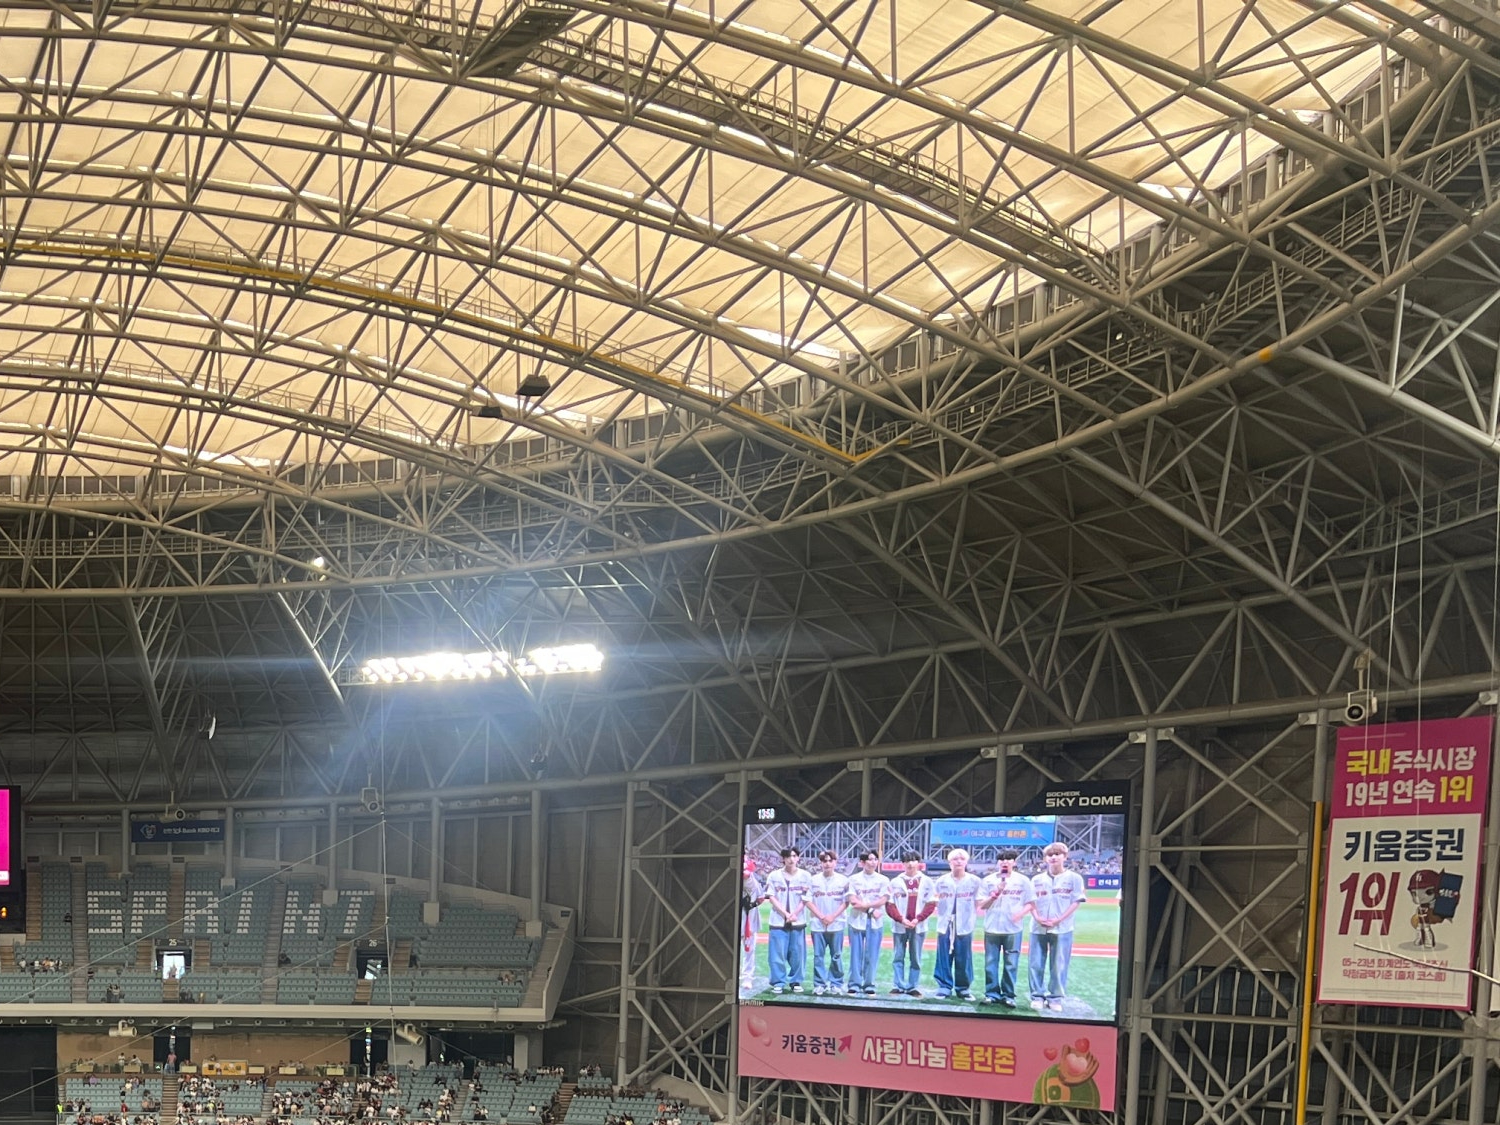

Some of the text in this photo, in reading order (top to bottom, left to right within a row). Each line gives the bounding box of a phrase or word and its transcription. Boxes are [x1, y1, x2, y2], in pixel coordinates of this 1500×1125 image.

[1347, 746, 1476, 776] 국내 주식시장
[1046, 795, 1122, 807] SKY DOME
[1346, 775, 1473, 806] 19년 연속 1위
[1344, 828, 1465, 862] 키움증권
[1338, 871, 1400, 936] 1위
[781, 1034, 1016, 1075] 키움증권 사랑 나눔 홈런존
